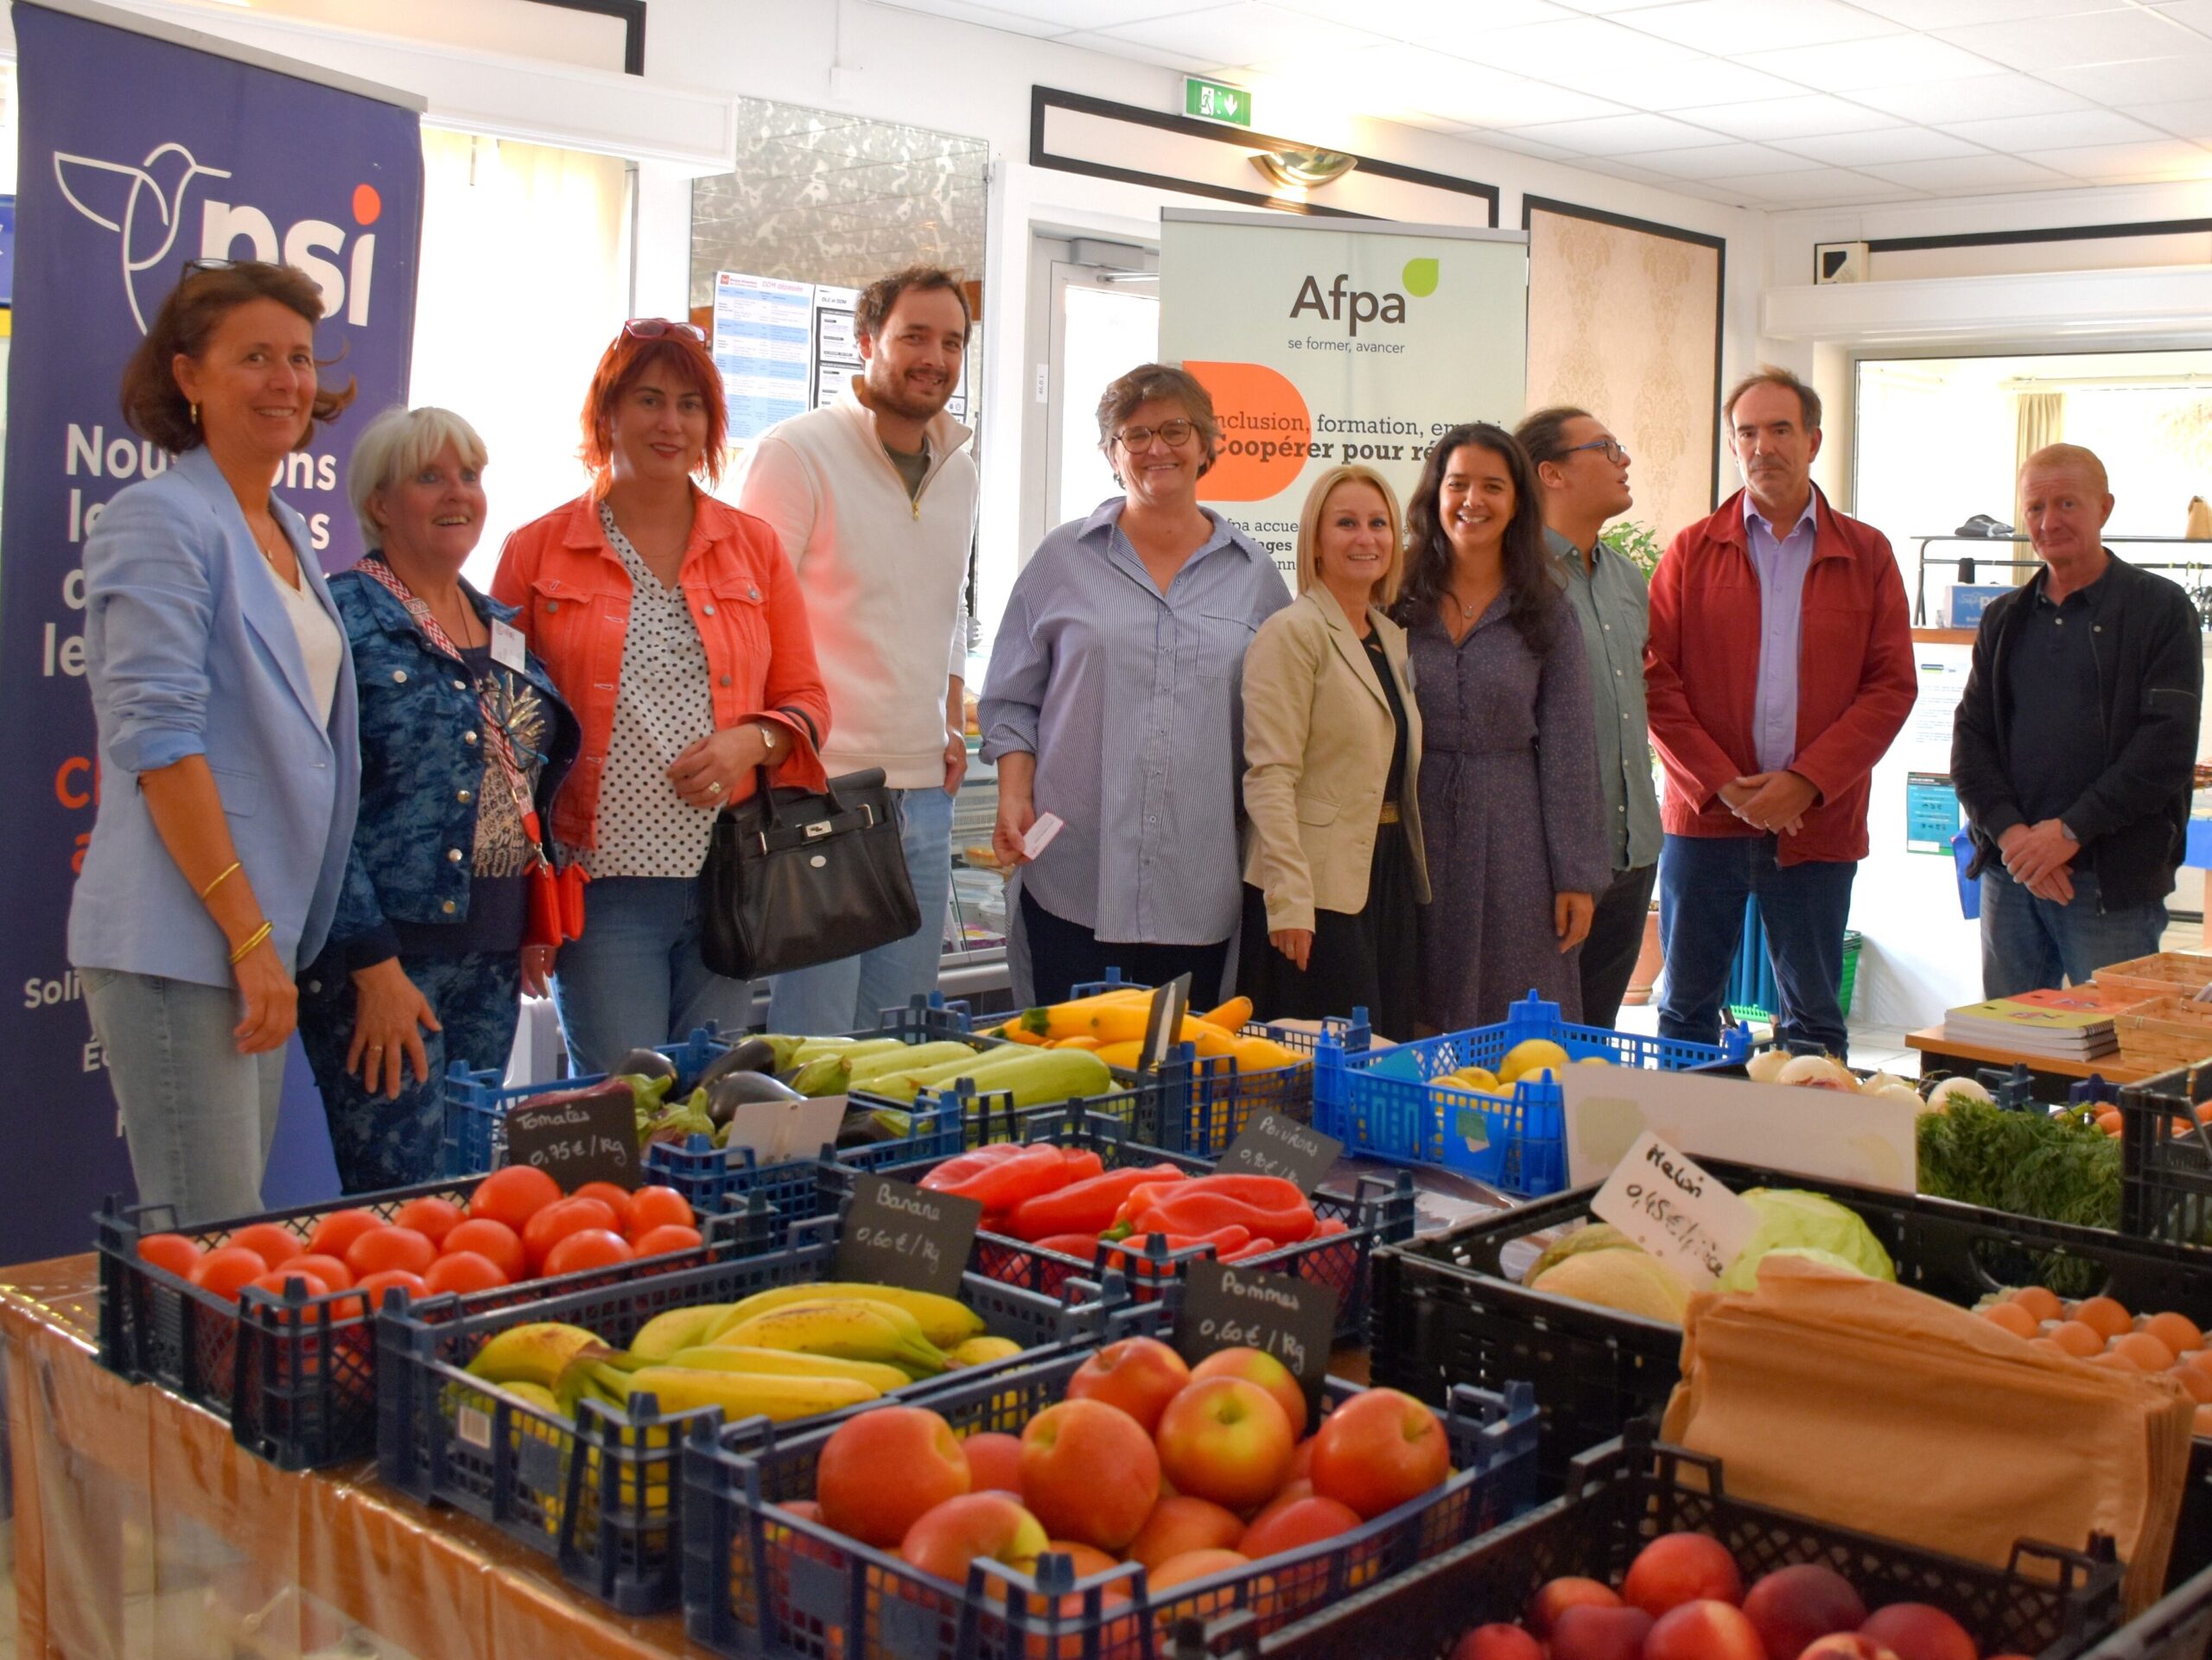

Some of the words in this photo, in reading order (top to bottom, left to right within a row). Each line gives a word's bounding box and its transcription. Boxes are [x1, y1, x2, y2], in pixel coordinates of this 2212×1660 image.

[1289, 274, 1405, 337] Afpa
[1287, 339, 1302, 349] se
[1306, 336, 1352, 353] former,
[1356, 342, 1405, 353] avancer
[1214, 411, 1309, 434] nclusion,
[1318, 414, 1424, 438] formation,
[67, 423, 179, 479] Nou
[1341, 443, 1404, 465] pour
[516, 1110, 590, 1129] Tomates
[1259, 1115, 1319, 1157] Poivrons
[1645, 1143, 1703, 1199] Melon
[876, 1183, 941, 1221] Banane
[1222, 1271, 1301, 1311] Pommes
